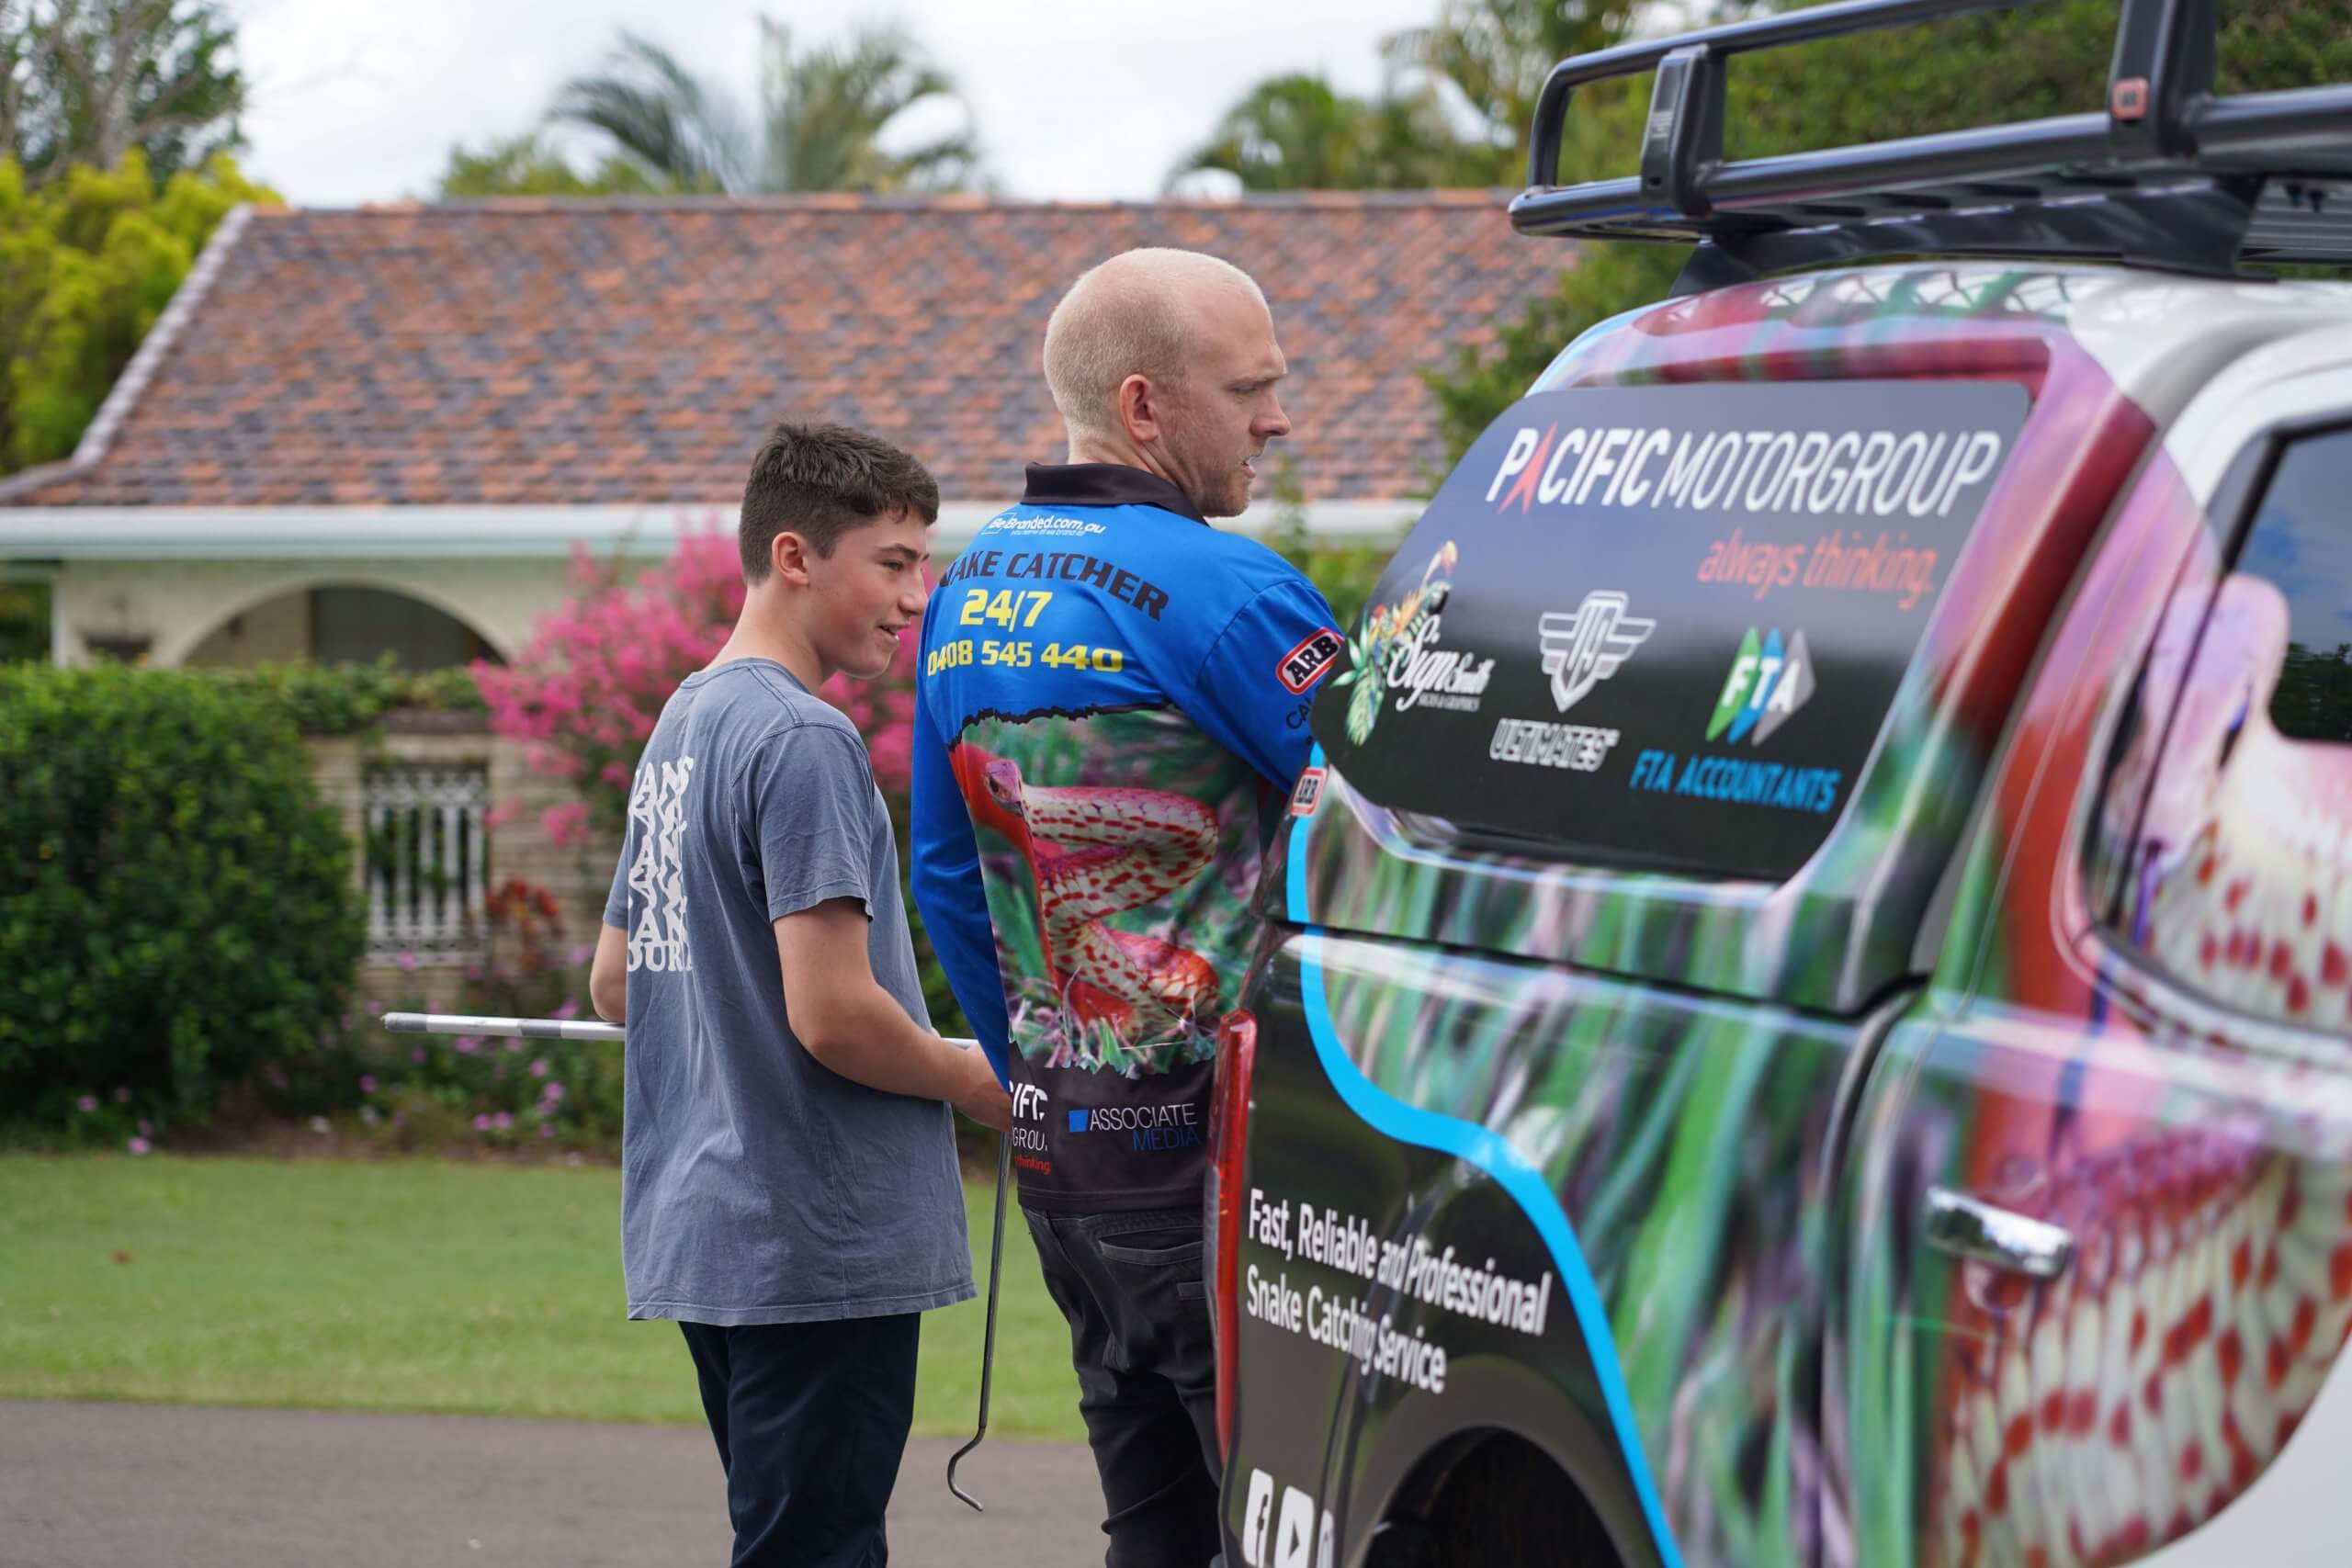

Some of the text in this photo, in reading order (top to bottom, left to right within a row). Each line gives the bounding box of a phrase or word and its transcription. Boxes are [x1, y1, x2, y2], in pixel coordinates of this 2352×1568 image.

[1486, 422, 2001, 516] PACIFIC MOTORGROUP
[1006, 553, 1170, 622] CATCHER
[1699, 528, 1806, 601] always
[959, 588, 1054, 633] 24/7
[927, 639, 1123, 677] 0408 545 440
[1285, 634, 1339, 686] ARB
[1721, 656, 1802, 714] FTA
[1629, 750, 1842, 814] FTA ACCOUNTANTS
[1090, 1103, 1198, 1131] ASSOCIATE
[1131, 1127, 1201, 1152] MEDIA
[1248, 1188, 1552, 1337] Fast, Reliable and Professional
[1247, 1263, 1447, 1394] Snake Catching Service
